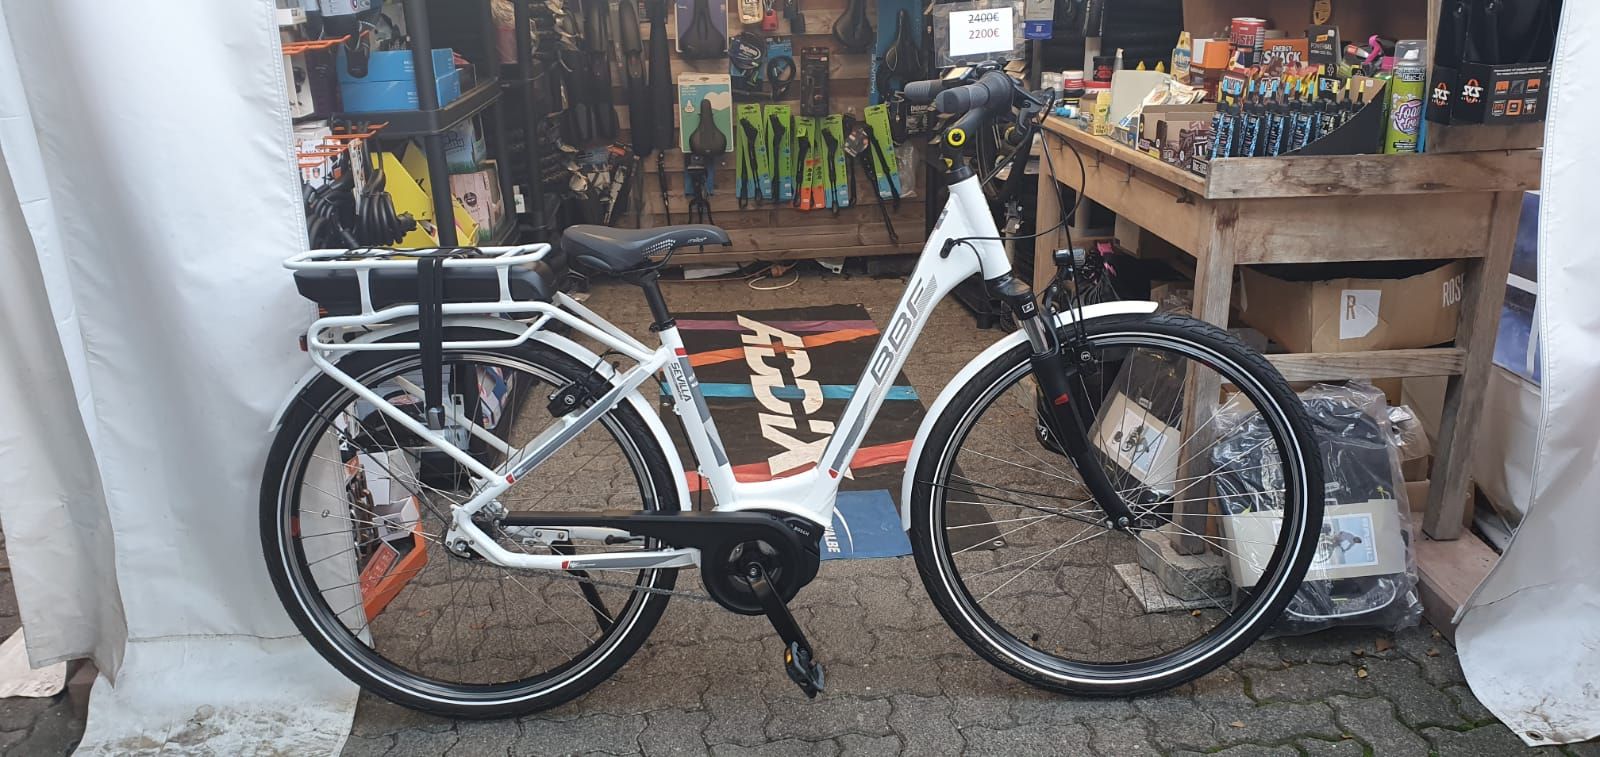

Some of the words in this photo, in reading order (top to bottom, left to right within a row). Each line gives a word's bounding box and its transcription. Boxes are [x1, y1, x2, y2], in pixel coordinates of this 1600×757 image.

[968, 12, 1000, 24] 2400€
[968, 28, 1000, 40] 2200€
[1263, 50, 1301, 64] SNACK
[1346, 295, 1357, 320] R
[871, 277, 924, 386] BBF
[671, 362, 692, 402] SEVILLA
[823, 527, 841, 553] ALBE
